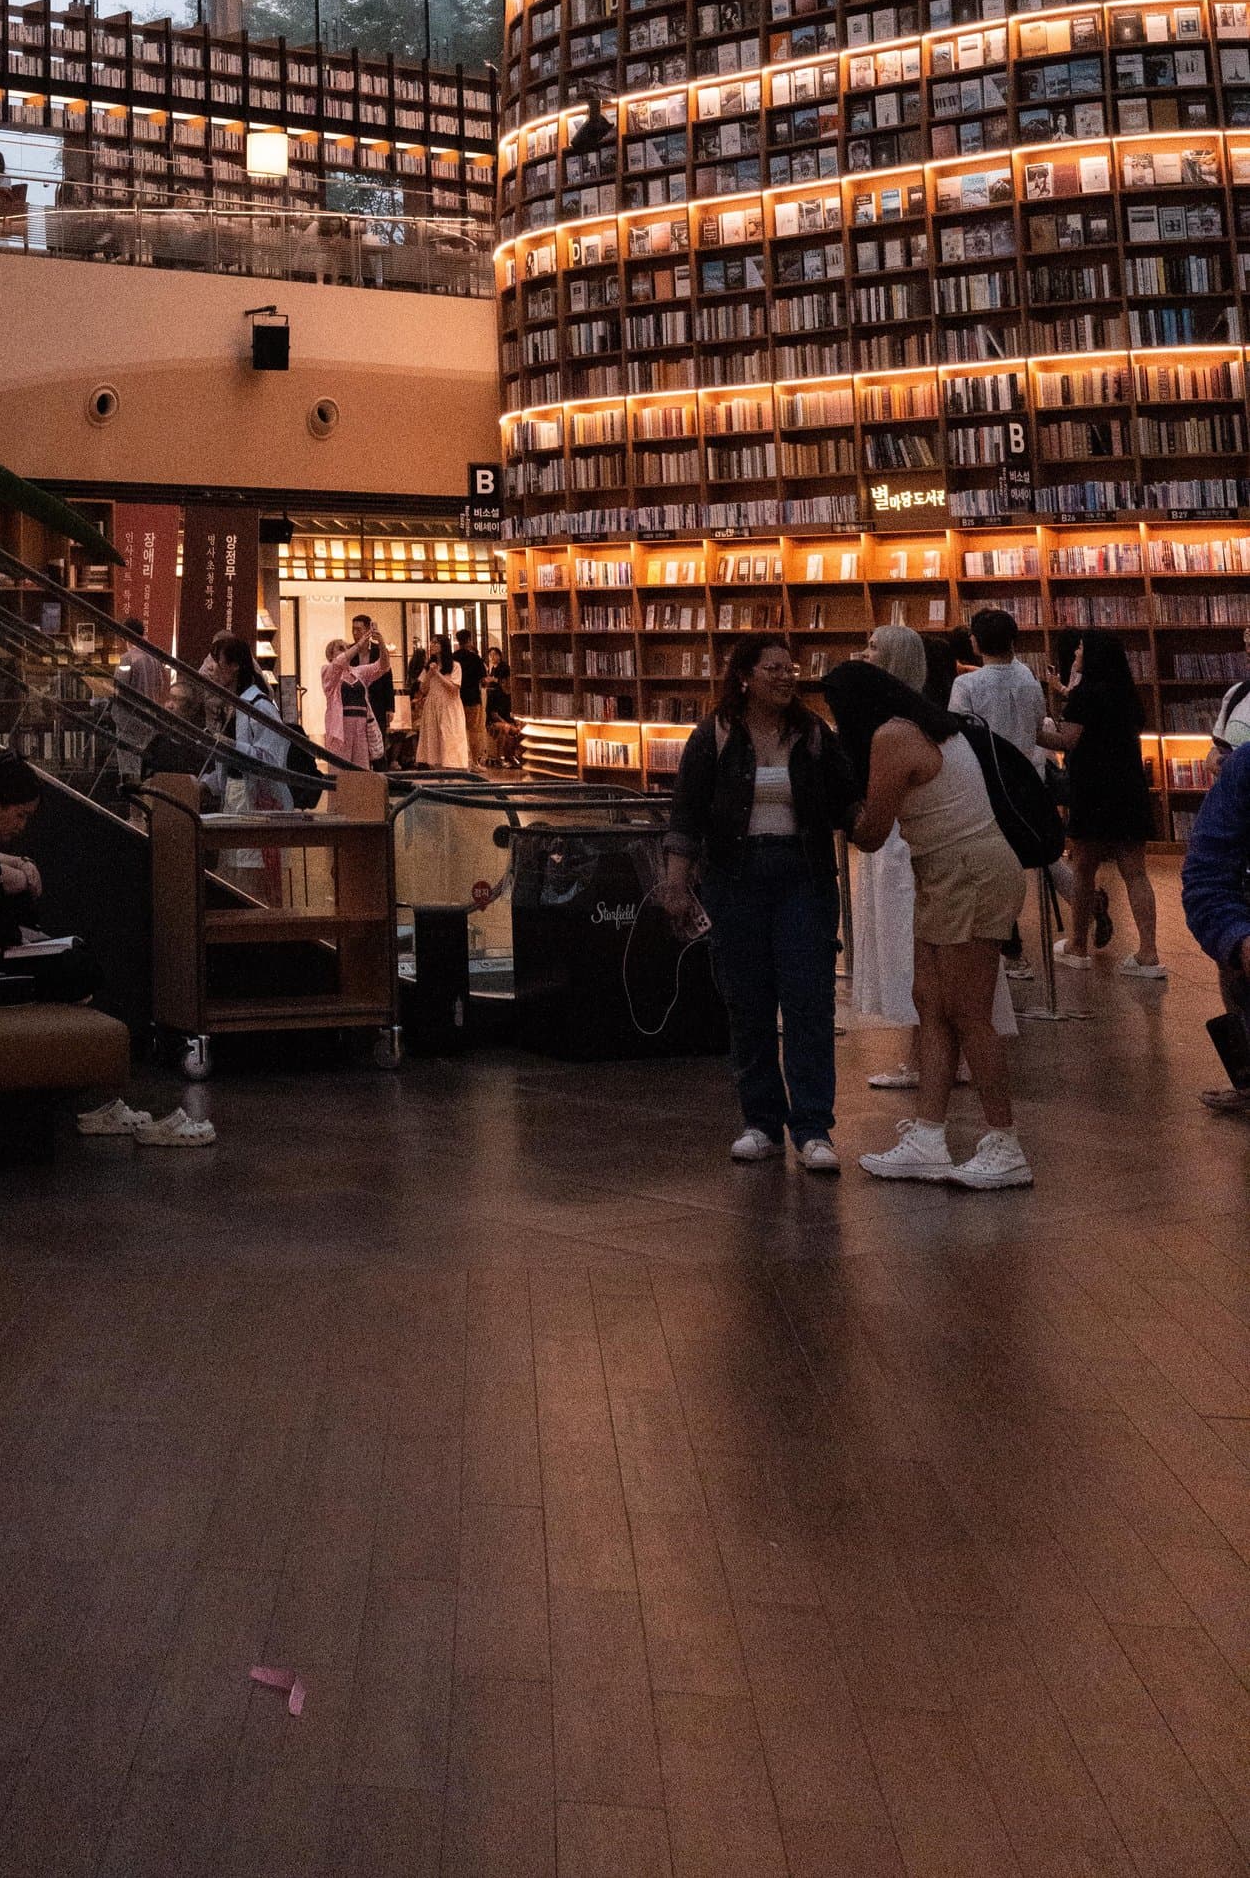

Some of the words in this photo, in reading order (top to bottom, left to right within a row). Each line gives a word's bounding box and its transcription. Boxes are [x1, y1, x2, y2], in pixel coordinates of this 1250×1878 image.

[1008, 422, 1025, 454] B
[476, 469, 495, 494] B
[1008, 470, 1031, 483] 비소설
[1009, 488, 1032, 502] 에세이
[473, 507, 500, 519] 비소설
[473, 521, 500, 533] 에세이
[590, 900, 636, 931] Starfield
